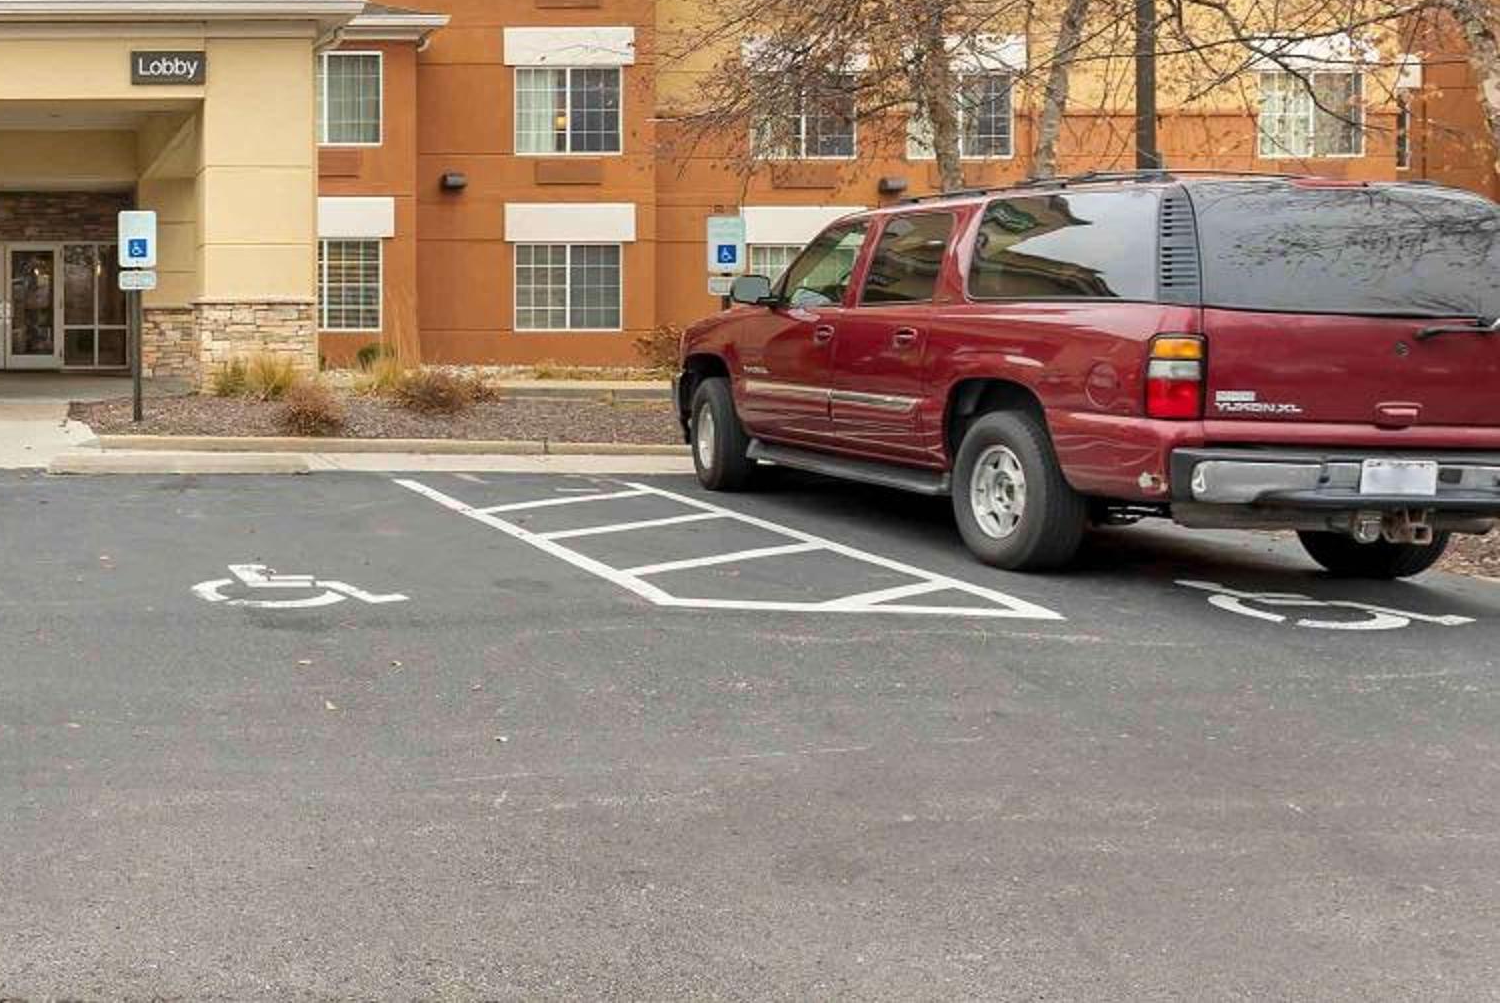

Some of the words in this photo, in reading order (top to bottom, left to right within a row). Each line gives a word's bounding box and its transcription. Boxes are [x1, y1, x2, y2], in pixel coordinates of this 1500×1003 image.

[138, 57, 198, 79] Lobby
[1214, 402, 1276, 413] YUKON
[1276, 403, 1303, 414] XL
